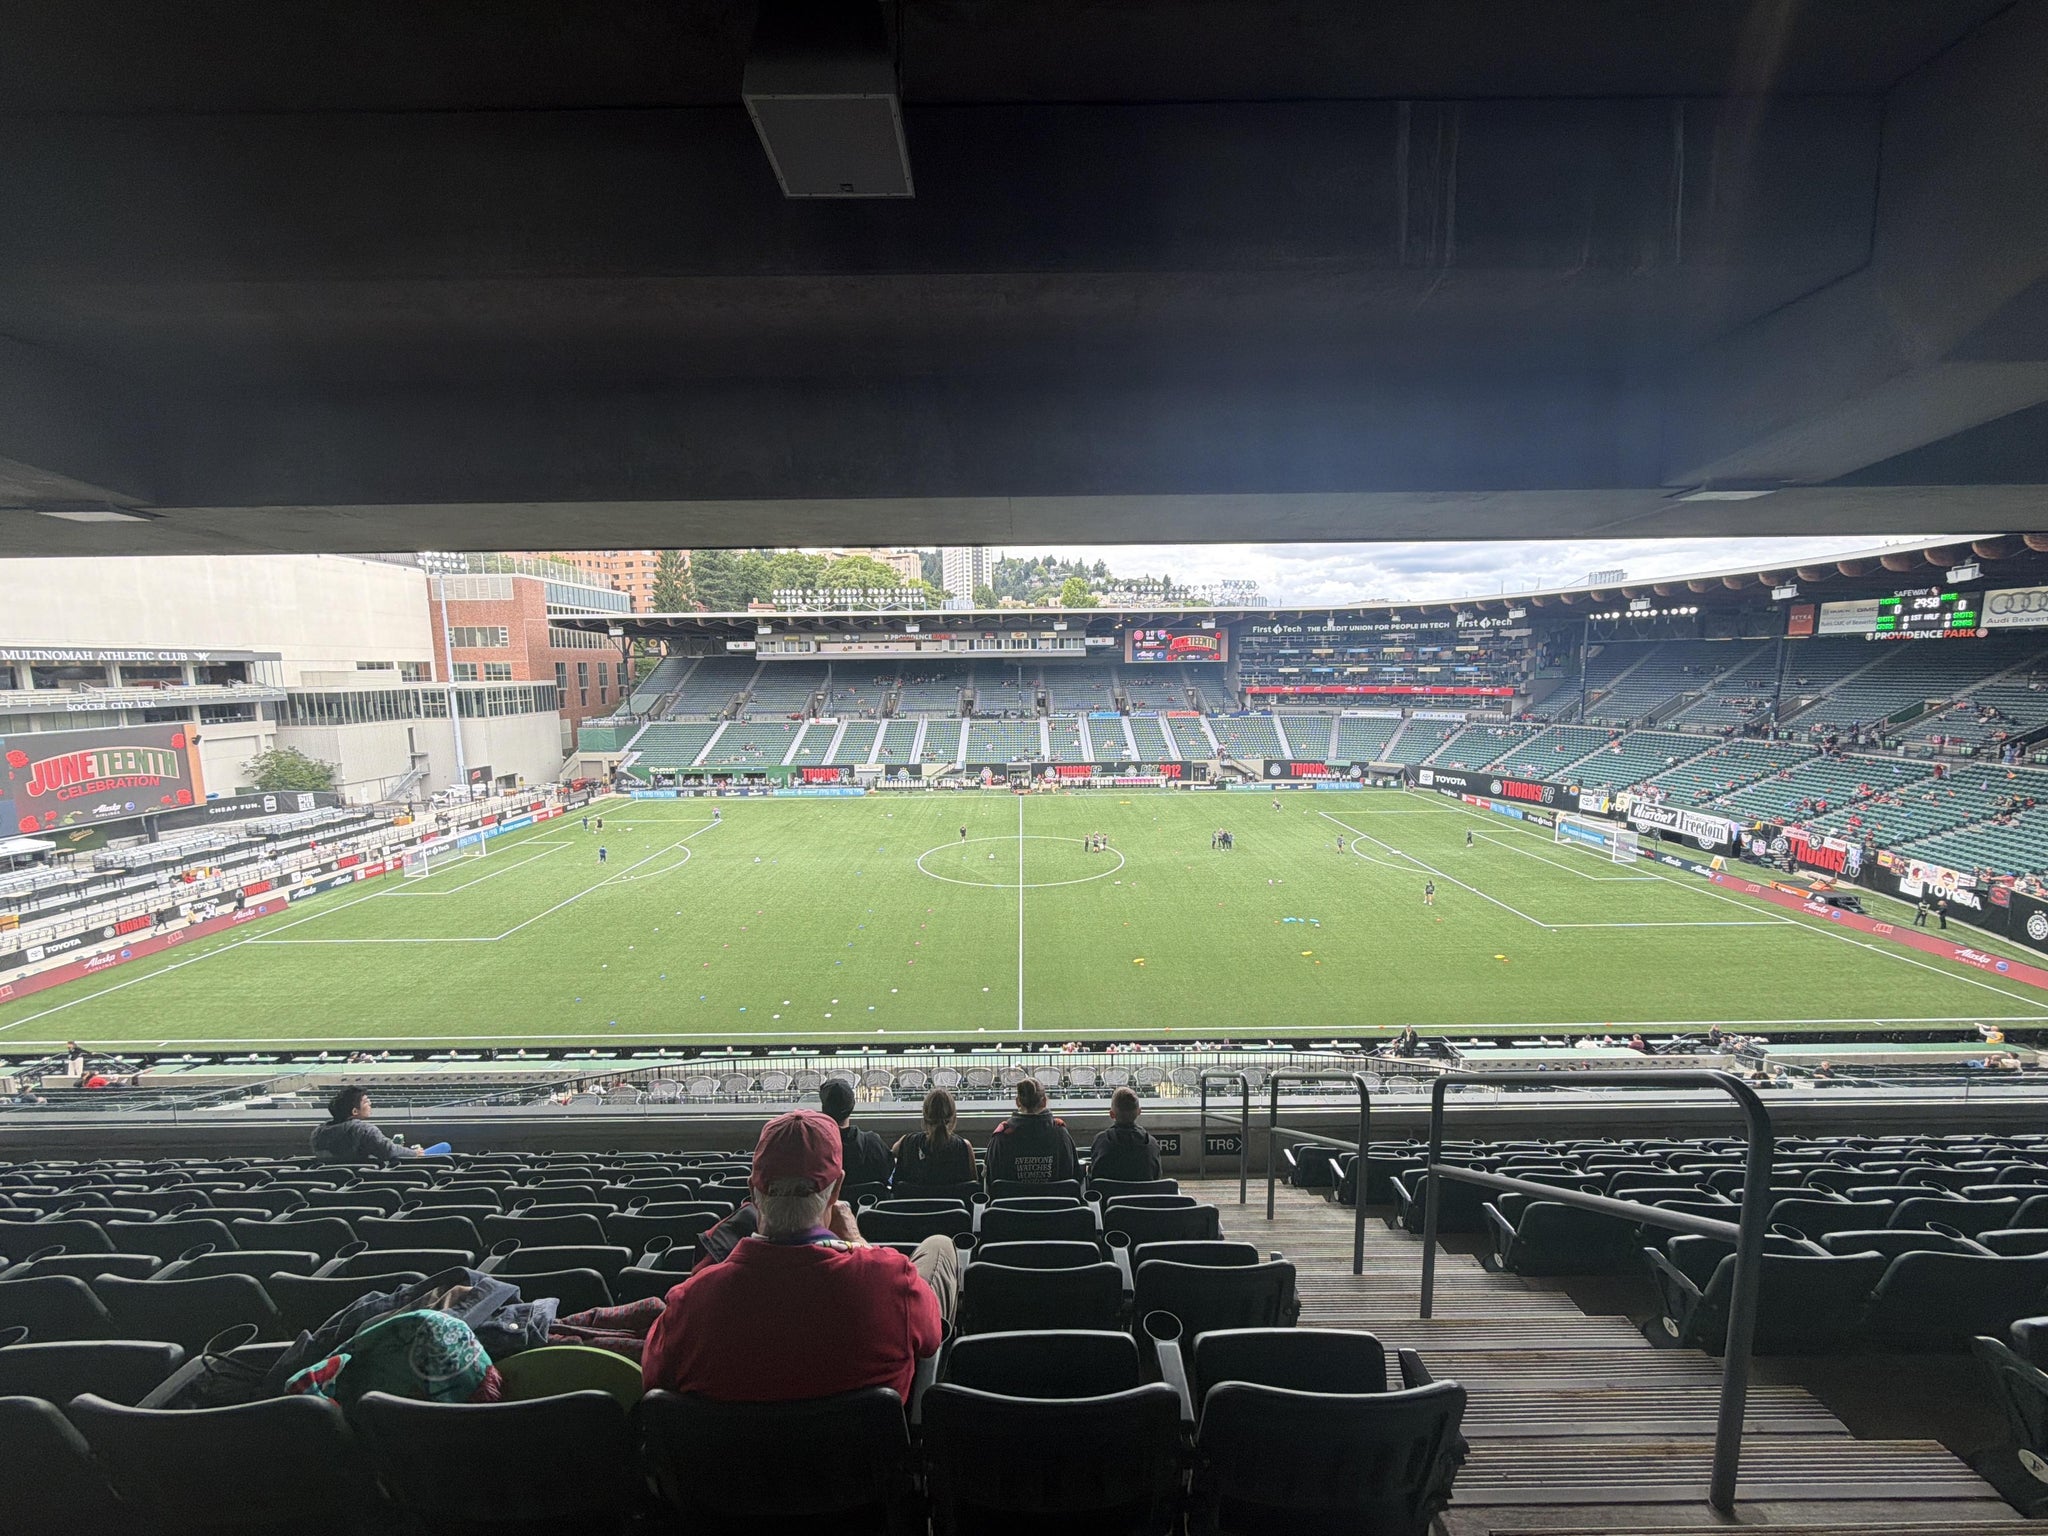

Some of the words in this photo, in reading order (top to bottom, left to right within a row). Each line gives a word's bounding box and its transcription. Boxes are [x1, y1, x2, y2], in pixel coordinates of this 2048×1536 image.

[1894, 588, 1929, 597] SAFEWAY
[1958, 600, 1967, 610] 0
[1953, 611, 1974, 619] SHOTS
[1456, 619, 1478, 628] First
[1491, 618, 1512, 626] Tech
[1, 649, 93, 661] MULTNOMAH
[98, 650, 155, 661] ATHLETIC
[158, 652, 188, 661] CLUB
[66, 703, 107, 712] SOCCER
[111, 701, 134, 709] CITY
[137, 700, 157, 709] USA
[26, 747, 180, 798] JUNETEENTH
[1435, 775, 1466, 786] TOYOTA
[56, 775, 160, 801] CELEBRATION
[209, 805, 237, 814] CHEAP
[1803, 901, 1829, 913] Alaska
[46, 938, 81, 953] TOYOTA
[83, 952, 116, 969] Alaska
[1954, 949, 1991, 963] Alaska
[1955, 956, 1985, 968] AIRLINES
[1156, 1139, 1177, 1151] R5
[1208, 1139, 1235, 1150] TR6
[1015, 1156, 1053, 1164] EVERYONE
[1017, 1171, 1052, 1180] WOMEN'S
